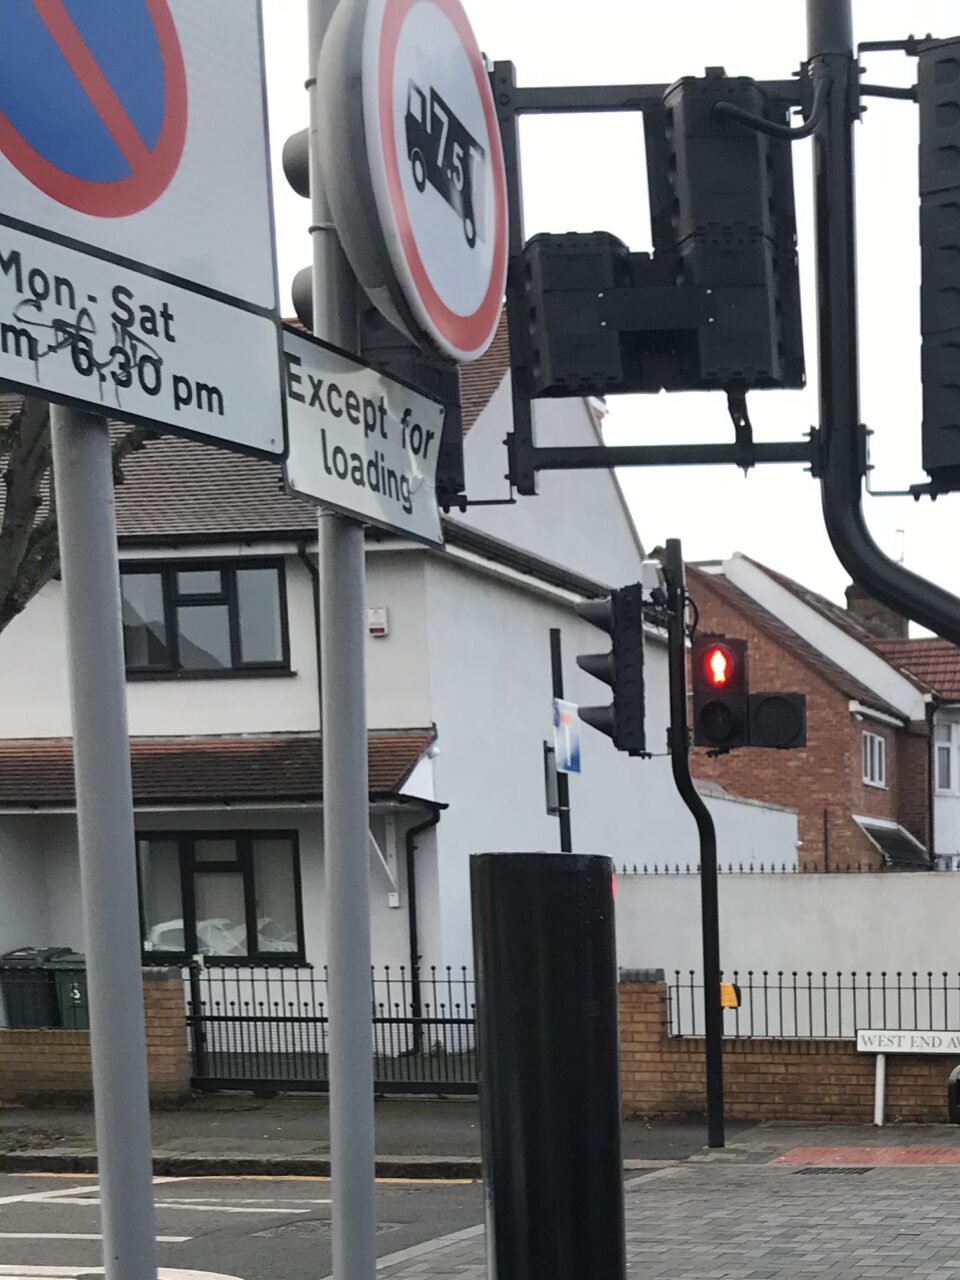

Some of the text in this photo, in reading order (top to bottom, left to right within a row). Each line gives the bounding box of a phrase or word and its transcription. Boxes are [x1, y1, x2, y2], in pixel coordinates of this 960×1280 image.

[0, 250, 76, 310] Mon
[111, 285, 176, 343] Sat
[71, 334, 162, 397] 6.30
[172, 374, 224, 416] pm
[284, 351, 435, 460] Except for
[320, 428, 414, 515] loading
[860, 1034, 905, 1047] WEST
[910, 1035, 942, 1048] END
